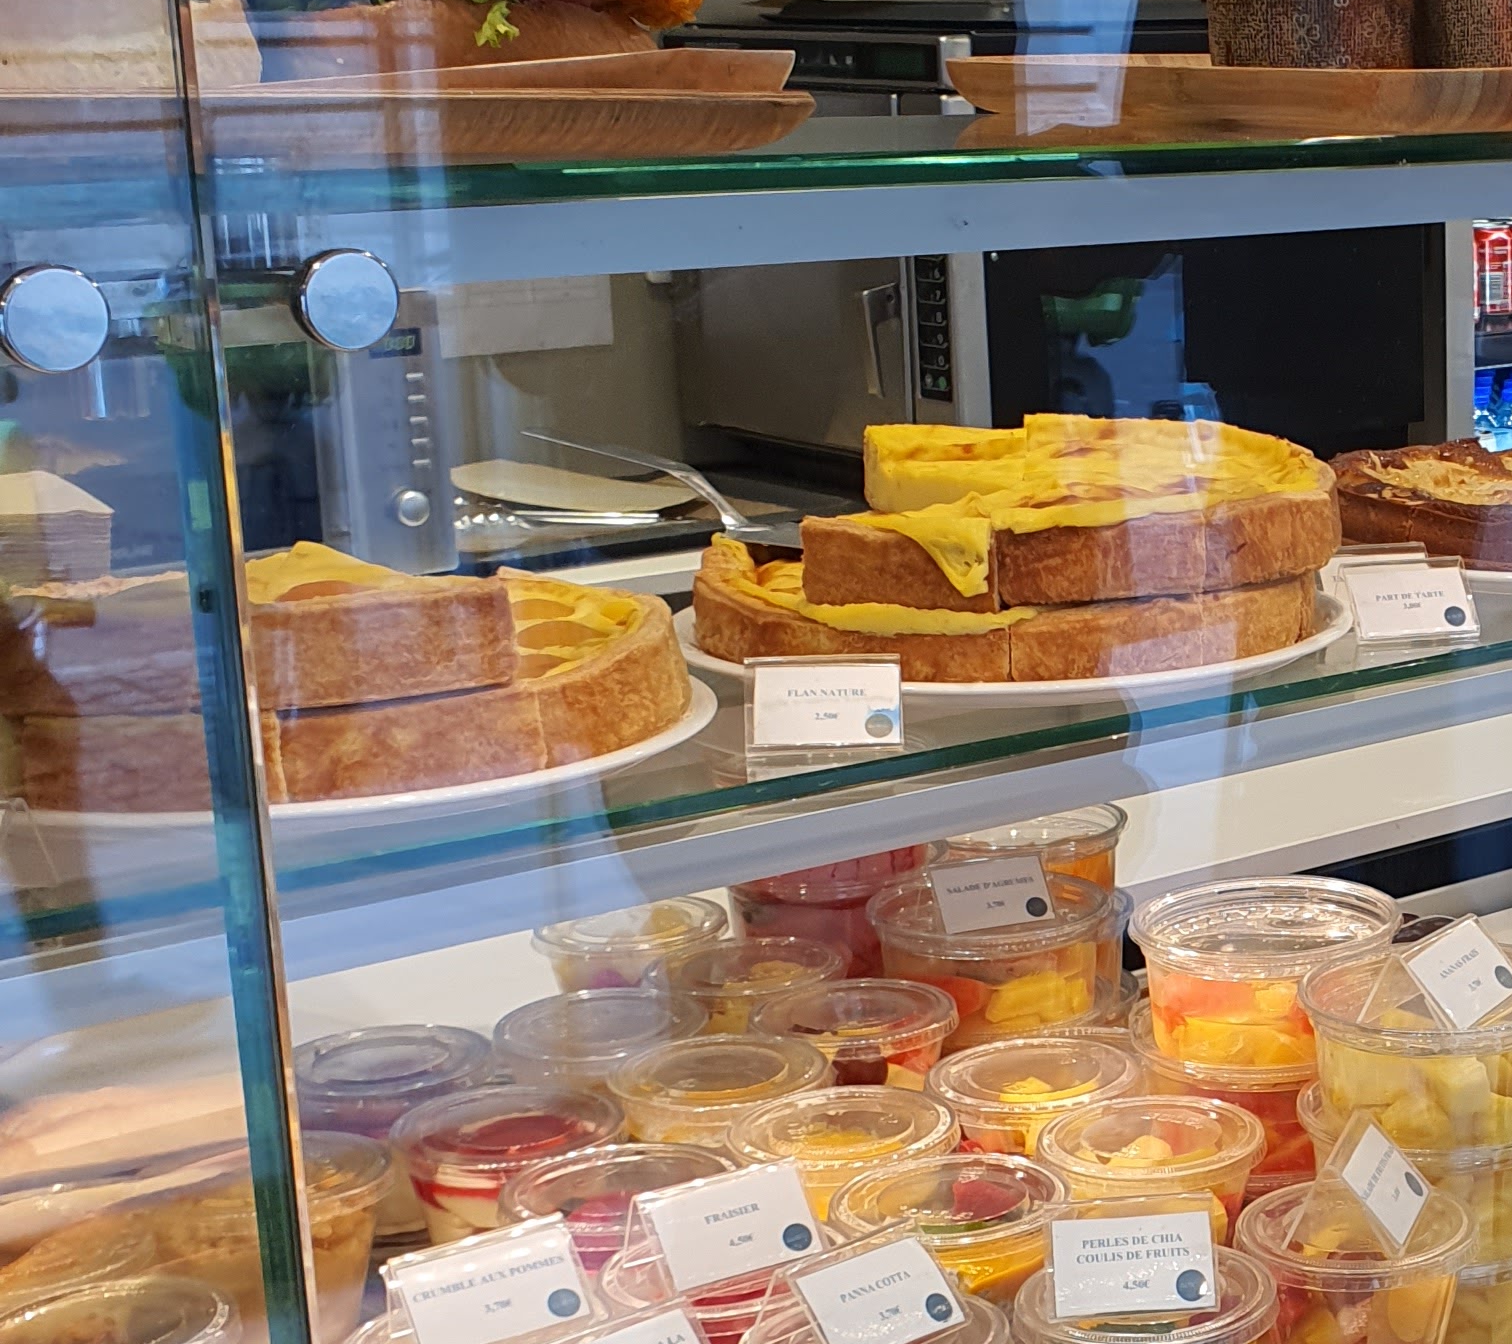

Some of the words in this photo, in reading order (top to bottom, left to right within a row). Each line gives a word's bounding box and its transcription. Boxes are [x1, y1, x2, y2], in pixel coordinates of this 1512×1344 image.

[1376, 594, 1399, 602] PART
[1415, 591, 1445, 599] TARTE
[788, 689, 818, 697] FLAN
[820, 688, 866, 697] NATURE
[946, 883, 981, 895] SALADE
[703, 1203, 760, 1225] FRAISIER
[1081, 1236, 1130, 1250] PERLES
[1131, 1235, 1149, 1246] DE
[1151, 1233, 1183, 1244] CHIA
[1076, 1252, 1124, 1265] COULIS
[1126, 1250, 1143, 1260] DE
[1146, 1247, 1190, 1259] FRUITS
[412, 1276, 476, 1304] CRUMBLE
[480, 1270, 508, 1285] AUX
[508, 1255, 566, 1278] POMMES
[839, 1284, 876, 1304] PANNA
[875, 1270, 911, 1290] COTTA
